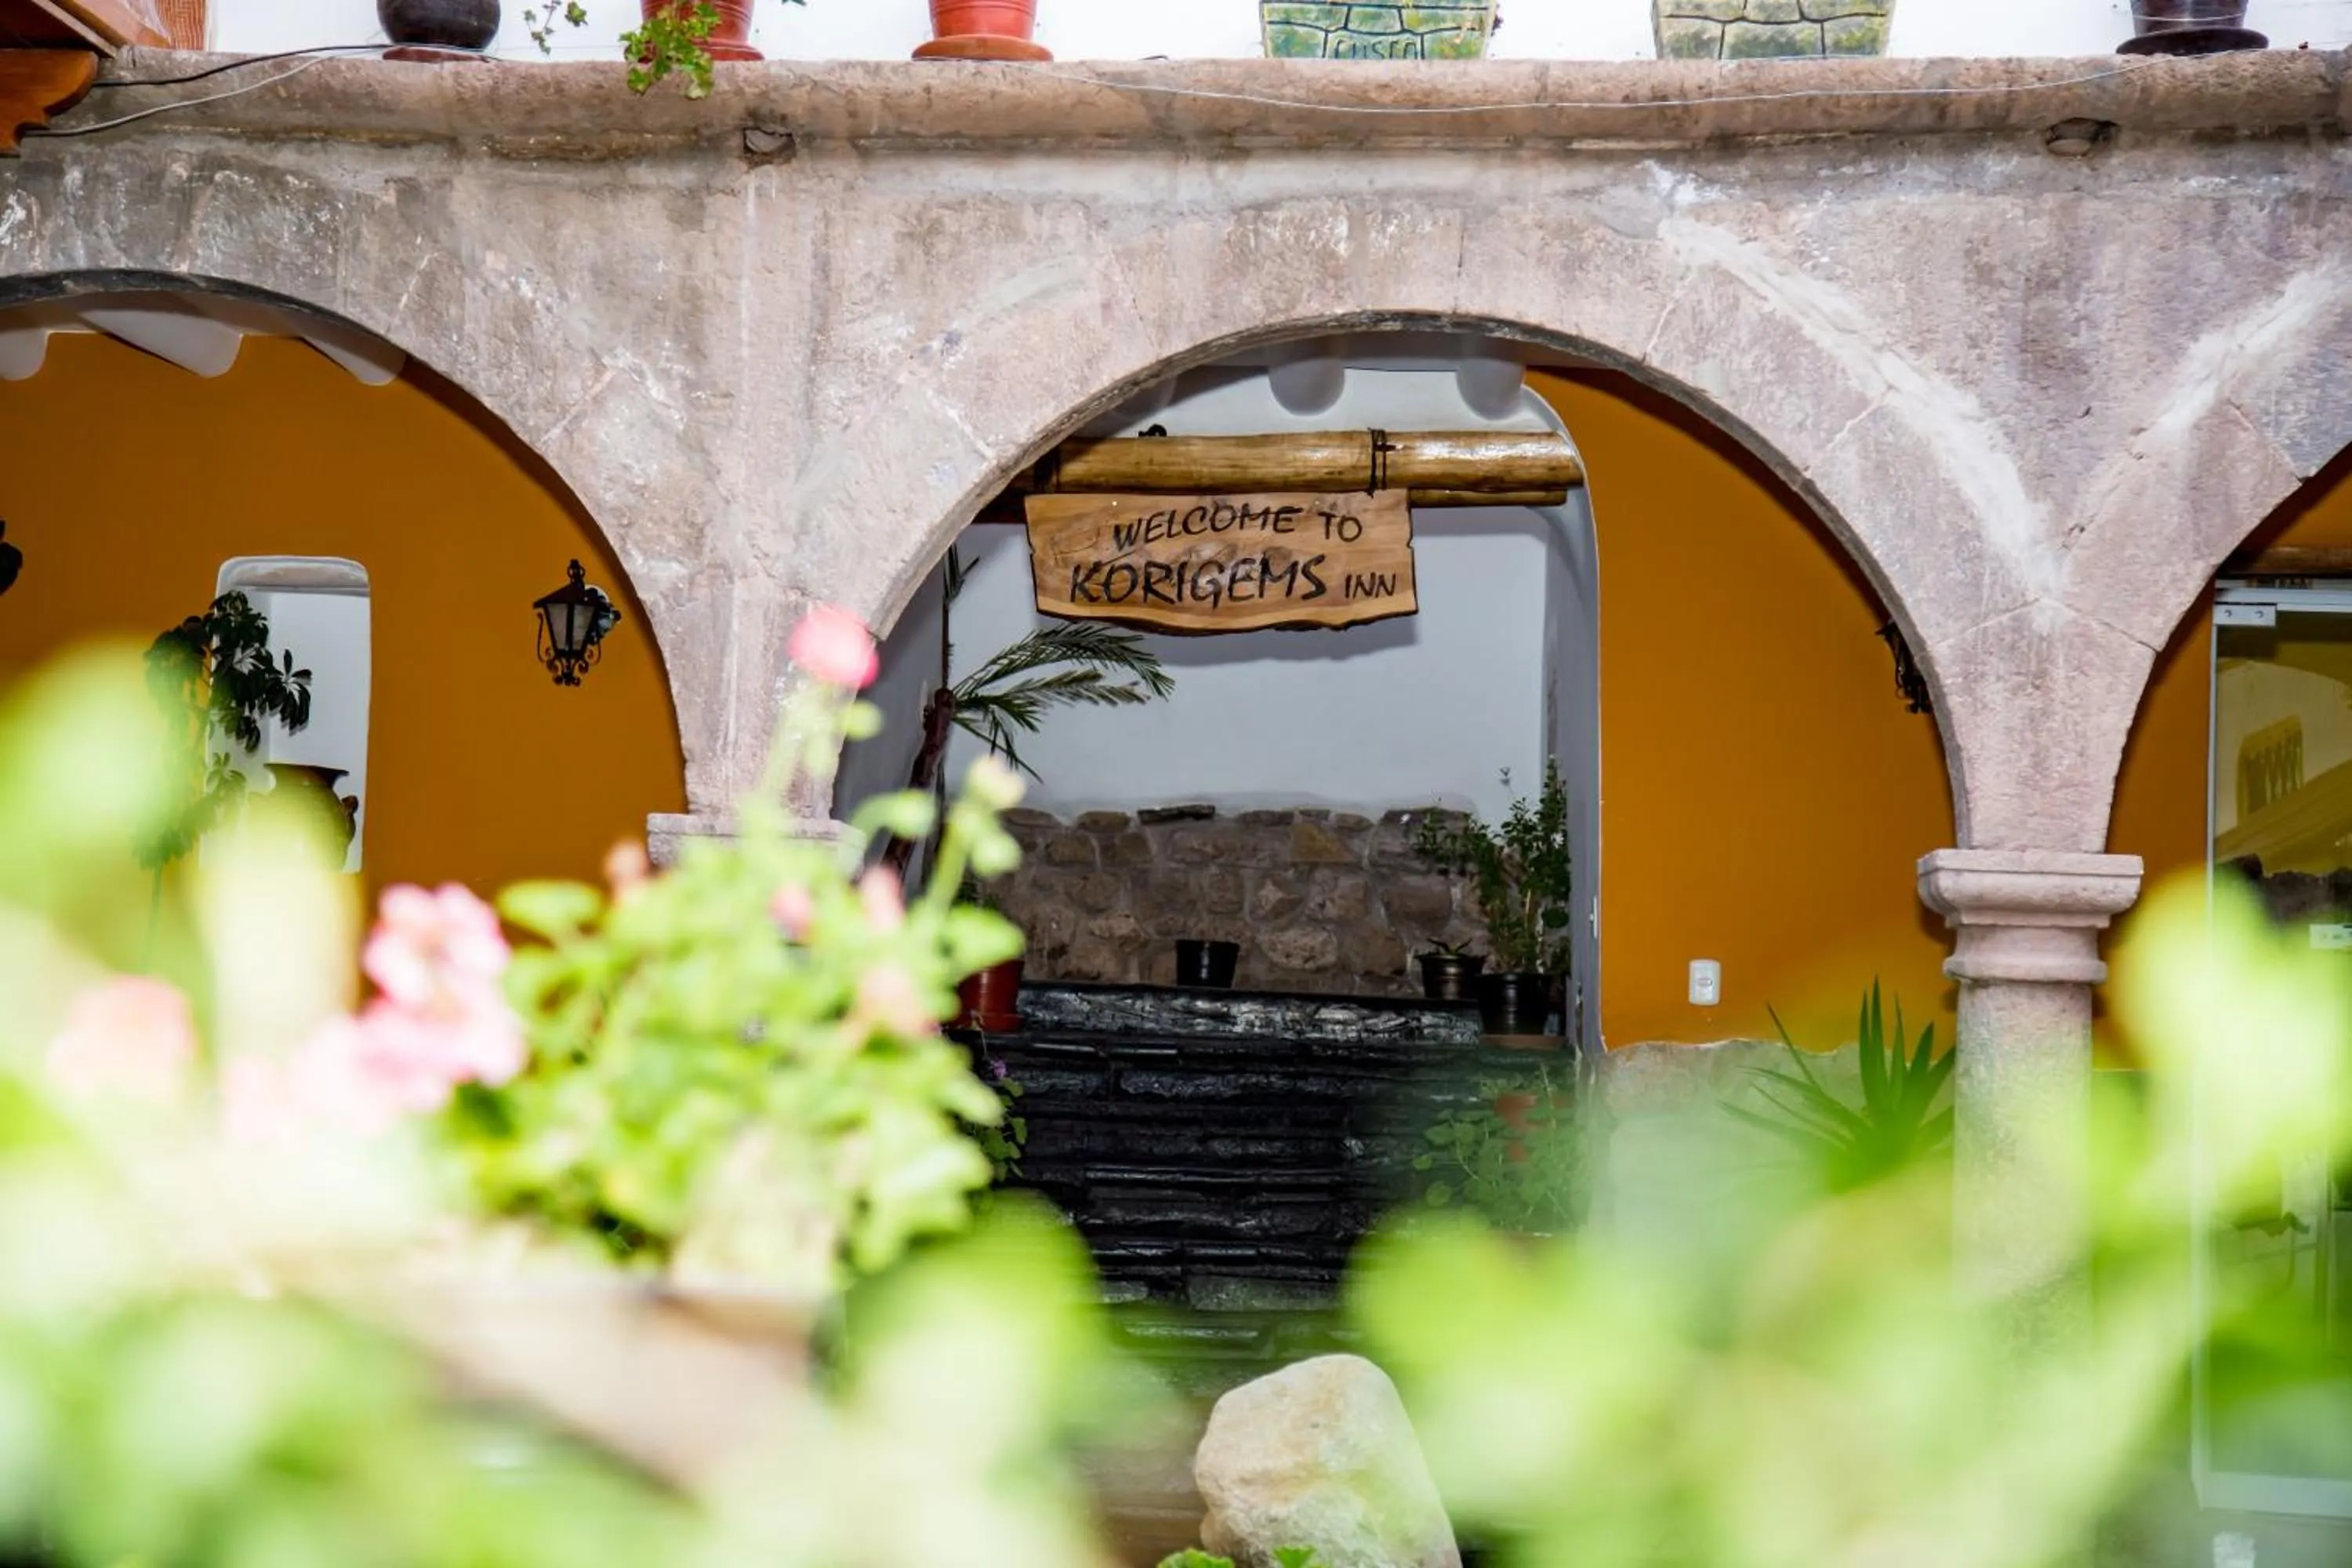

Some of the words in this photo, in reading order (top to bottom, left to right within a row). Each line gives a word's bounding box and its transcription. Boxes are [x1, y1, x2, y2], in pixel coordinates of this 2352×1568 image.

[1113, 503, 1304, 551] WELCOME
[1319, 510, 1363, 541] TO
[1069, 554, 1327, 608] KORIGEMS
[1344, 572, 1396, 599] INN
